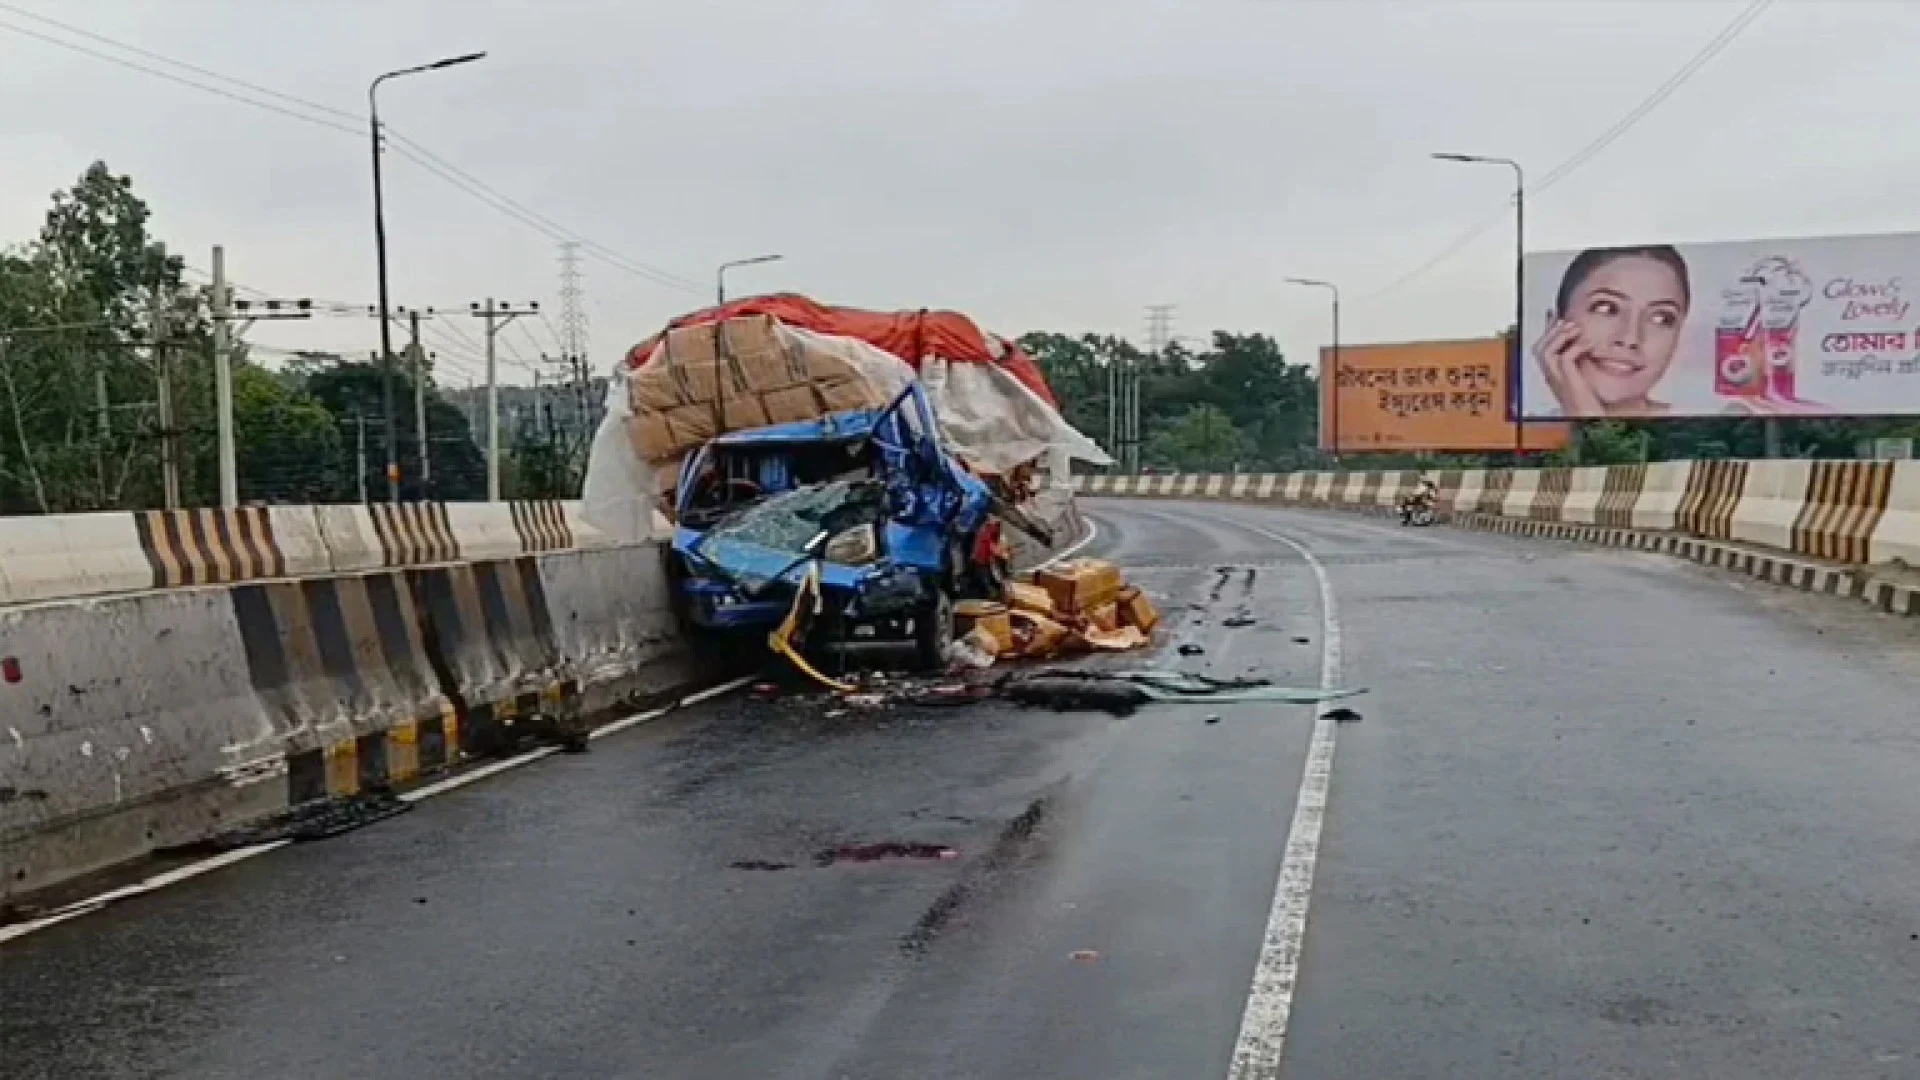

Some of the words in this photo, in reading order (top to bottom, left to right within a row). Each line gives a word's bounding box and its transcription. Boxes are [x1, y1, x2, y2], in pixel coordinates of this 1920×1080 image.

[1840, 296, 1911, 321] Lovely
[1820, 332, 1906, 353] তোমার
[1450, 391, 1492, 416] করুন
